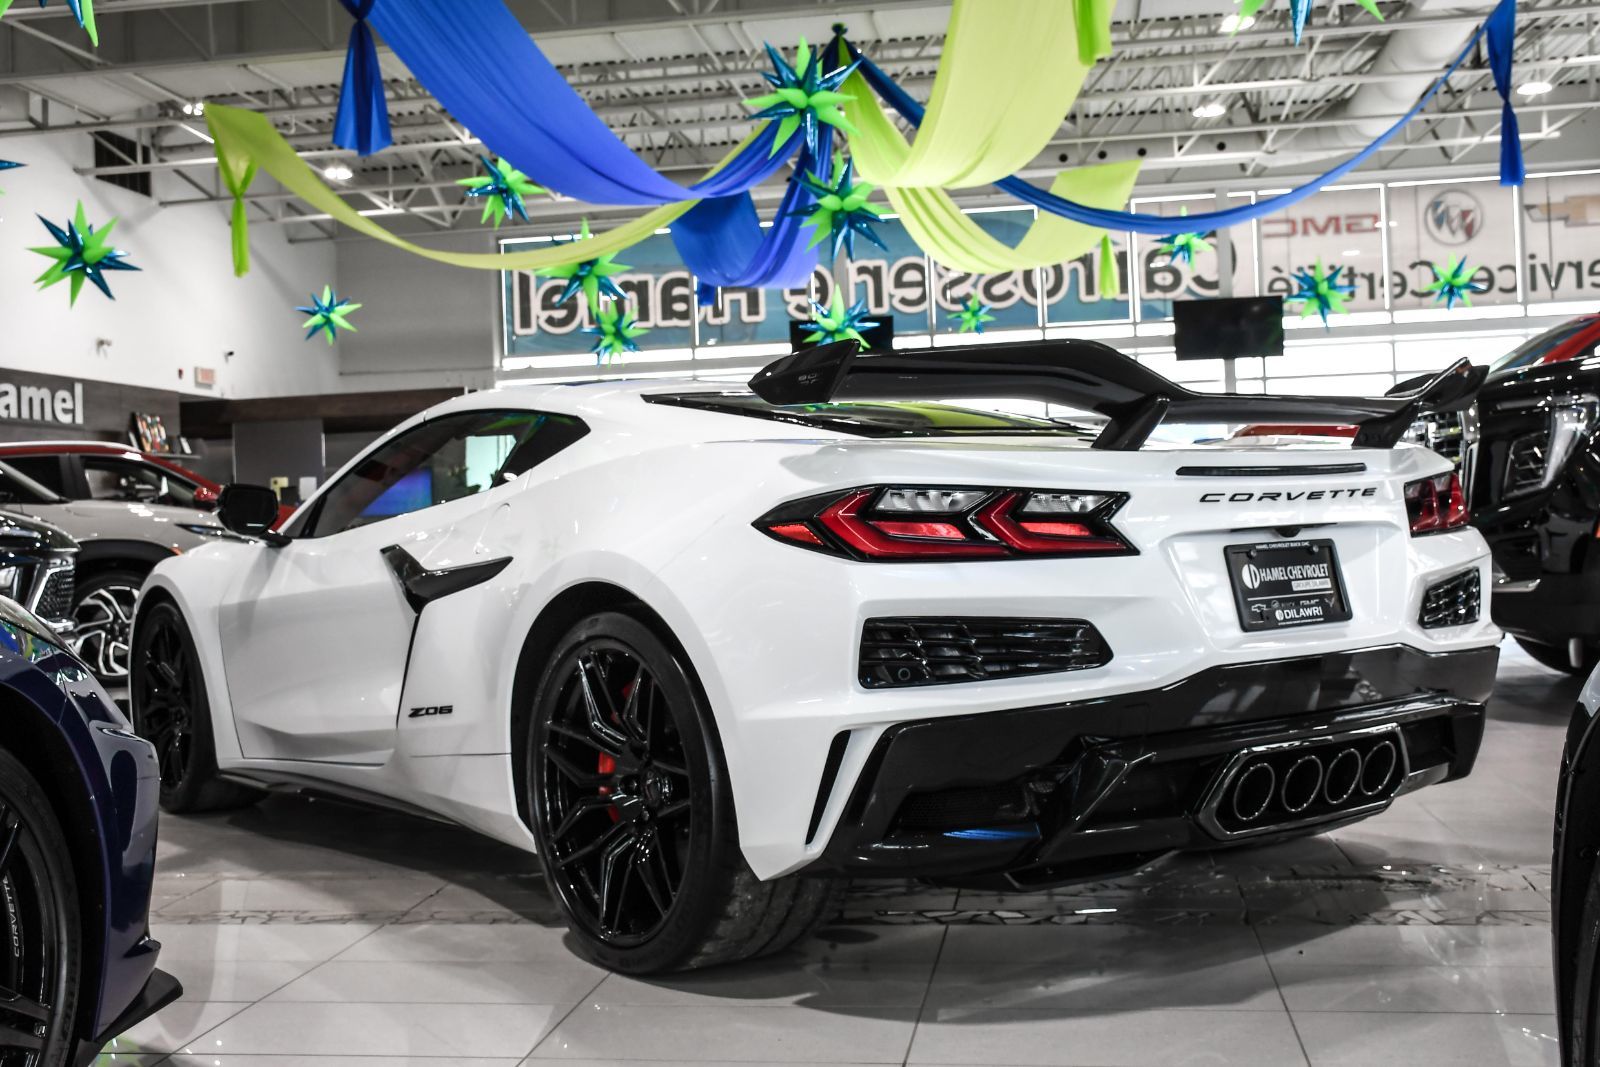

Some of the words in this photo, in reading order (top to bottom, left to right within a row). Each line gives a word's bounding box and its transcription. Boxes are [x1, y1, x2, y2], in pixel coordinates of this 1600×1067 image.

[1199, 487, 1377, 503] CORVETTE
[1259, 566, 1288, 582] HAMEL
[1288, 563, 1329, 580] CHEVROLET
[1284, 606, 1323, 619] DILAWRI
[408, 705, 453, 718] Z06
